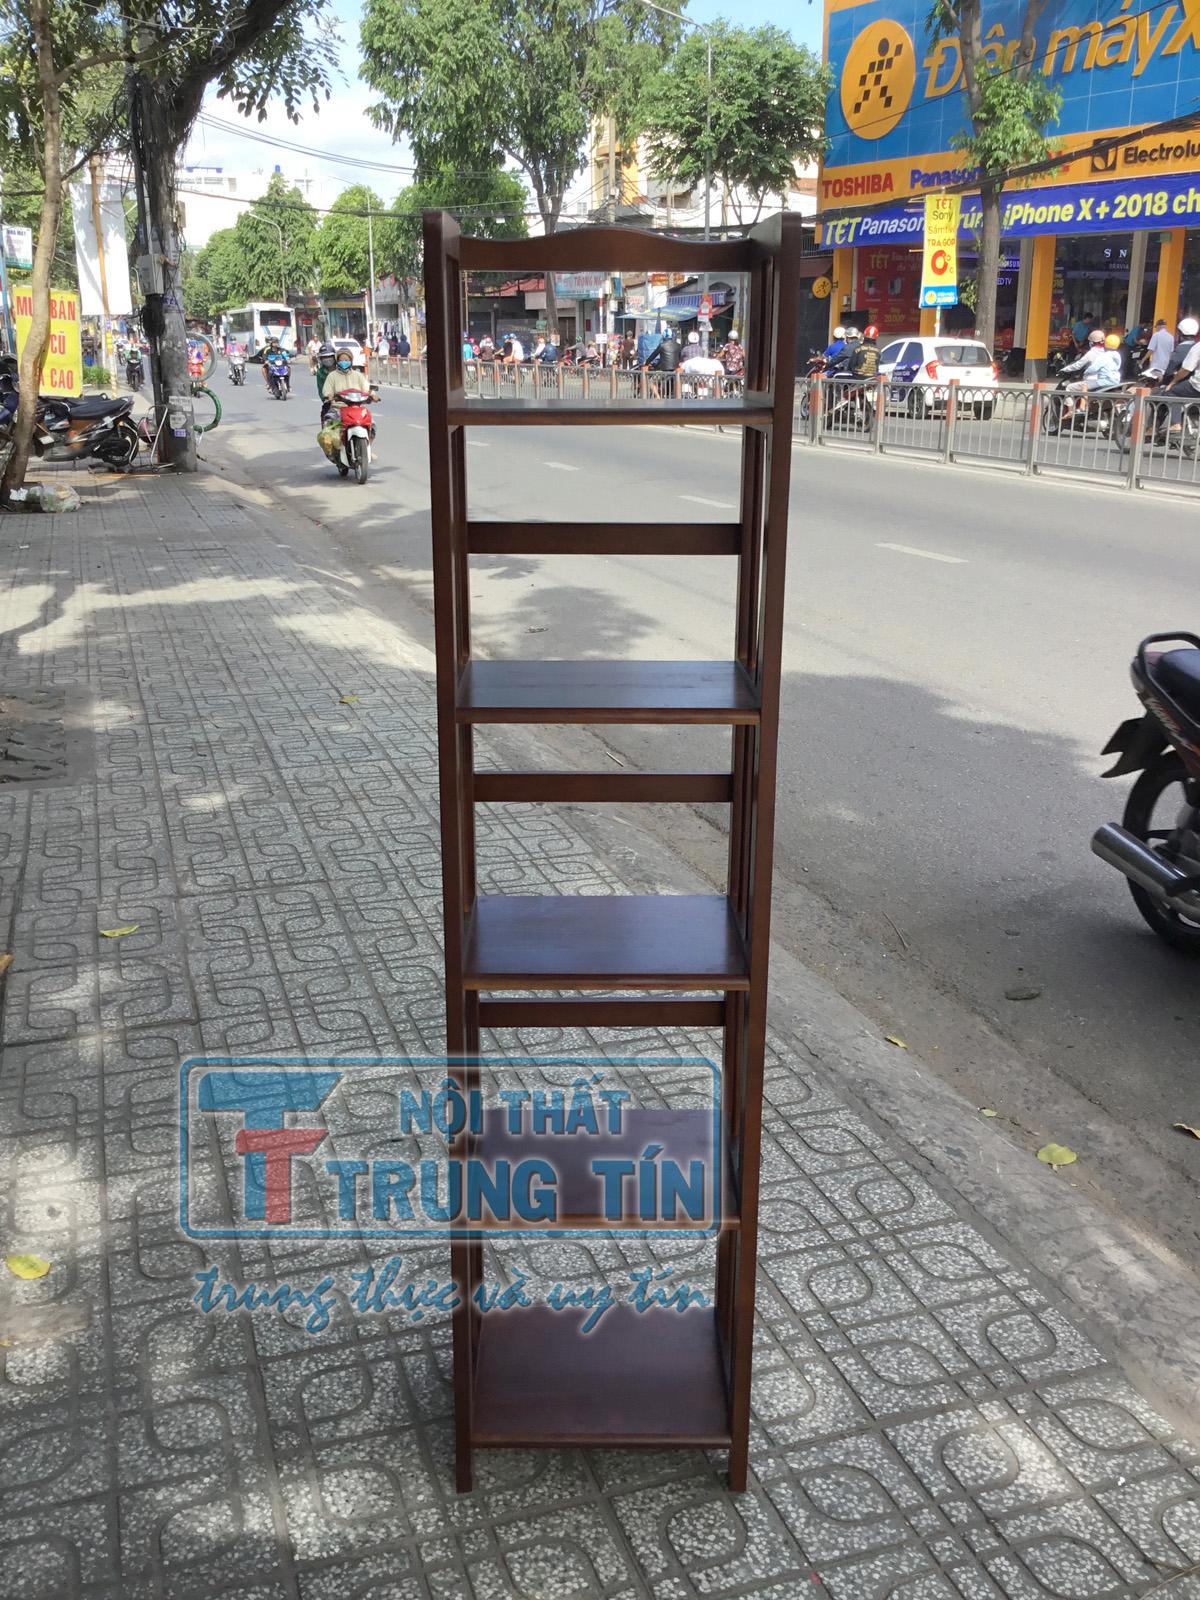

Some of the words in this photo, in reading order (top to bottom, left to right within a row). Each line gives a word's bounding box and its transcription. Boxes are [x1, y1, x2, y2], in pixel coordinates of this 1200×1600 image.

[822, 172, 894, 199] TOSHIBA
[932, 211, 953, 222] Sony
[1002, 203, 1074, 227] iPhone
[1076, 198, 1095, 221] X
[1112, 191, 1168, 219] 2018
[50, 367, 74, 390] CAO
